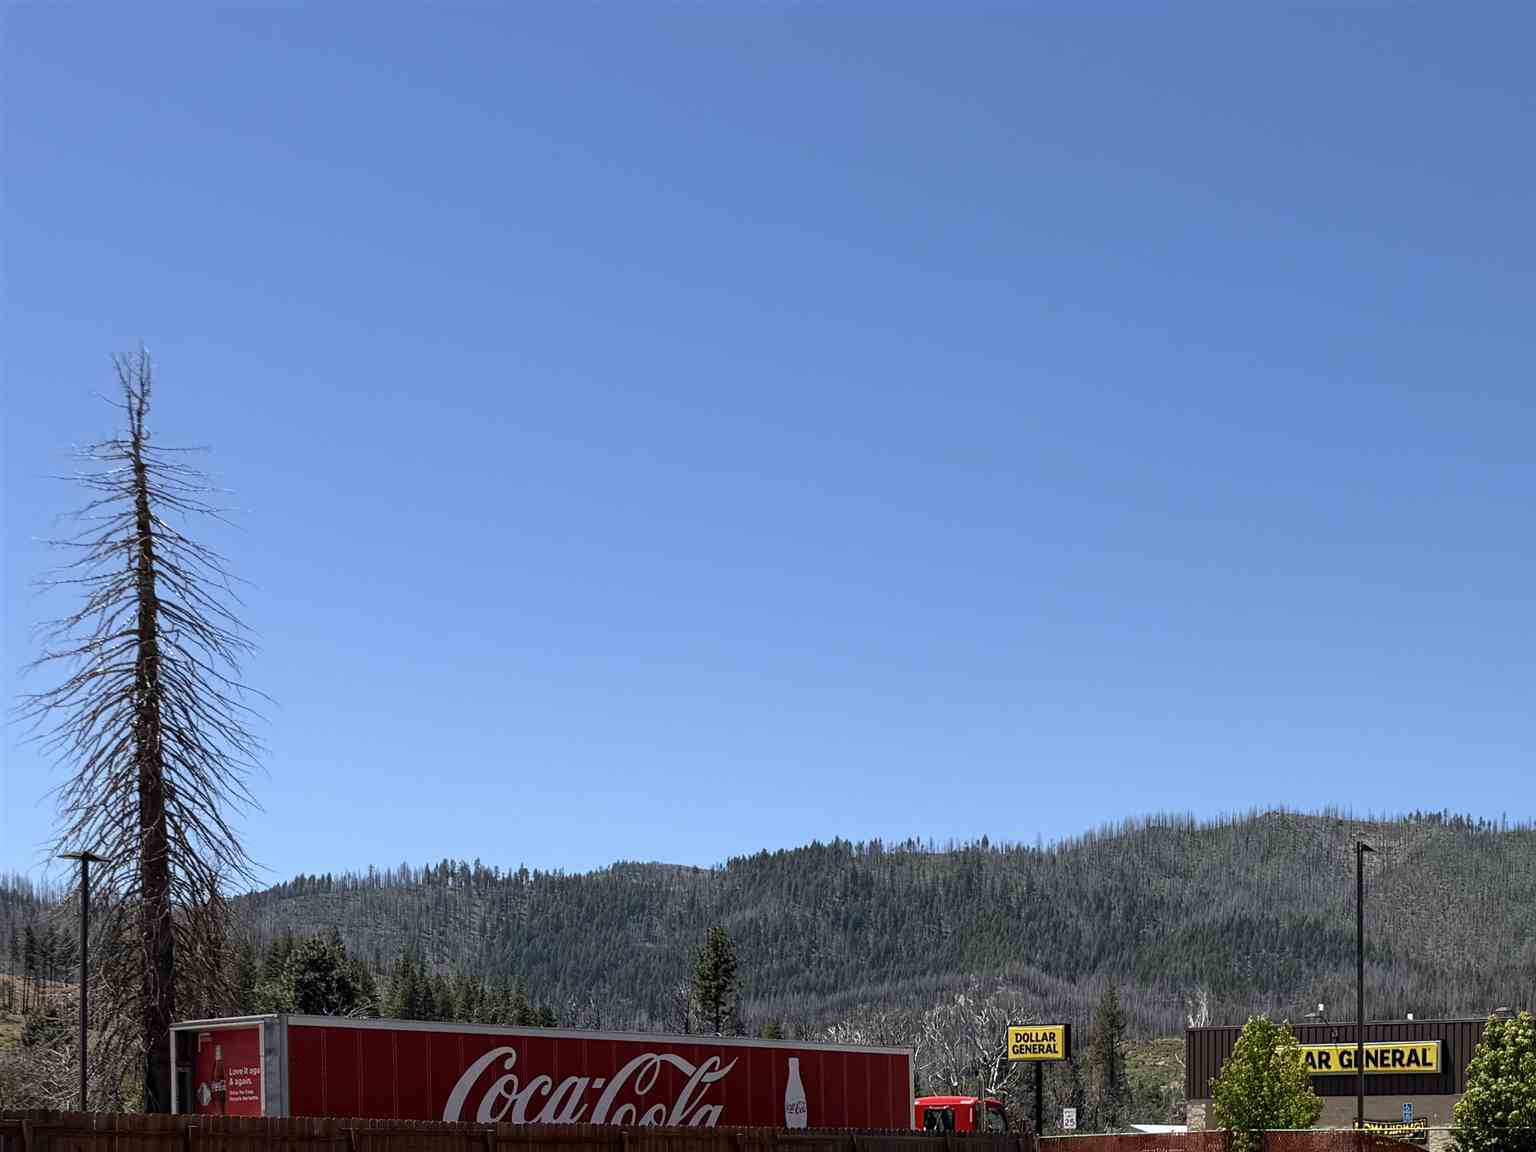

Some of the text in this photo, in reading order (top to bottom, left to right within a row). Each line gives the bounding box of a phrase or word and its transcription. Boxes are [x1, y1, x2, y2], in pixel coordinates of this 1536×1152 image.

[1014, 1032, 1057, 1043] DOLLAR
[1012, 1043, 1059, 1055] GENERAL
[1064, 1118, 1075, 1126] 25
